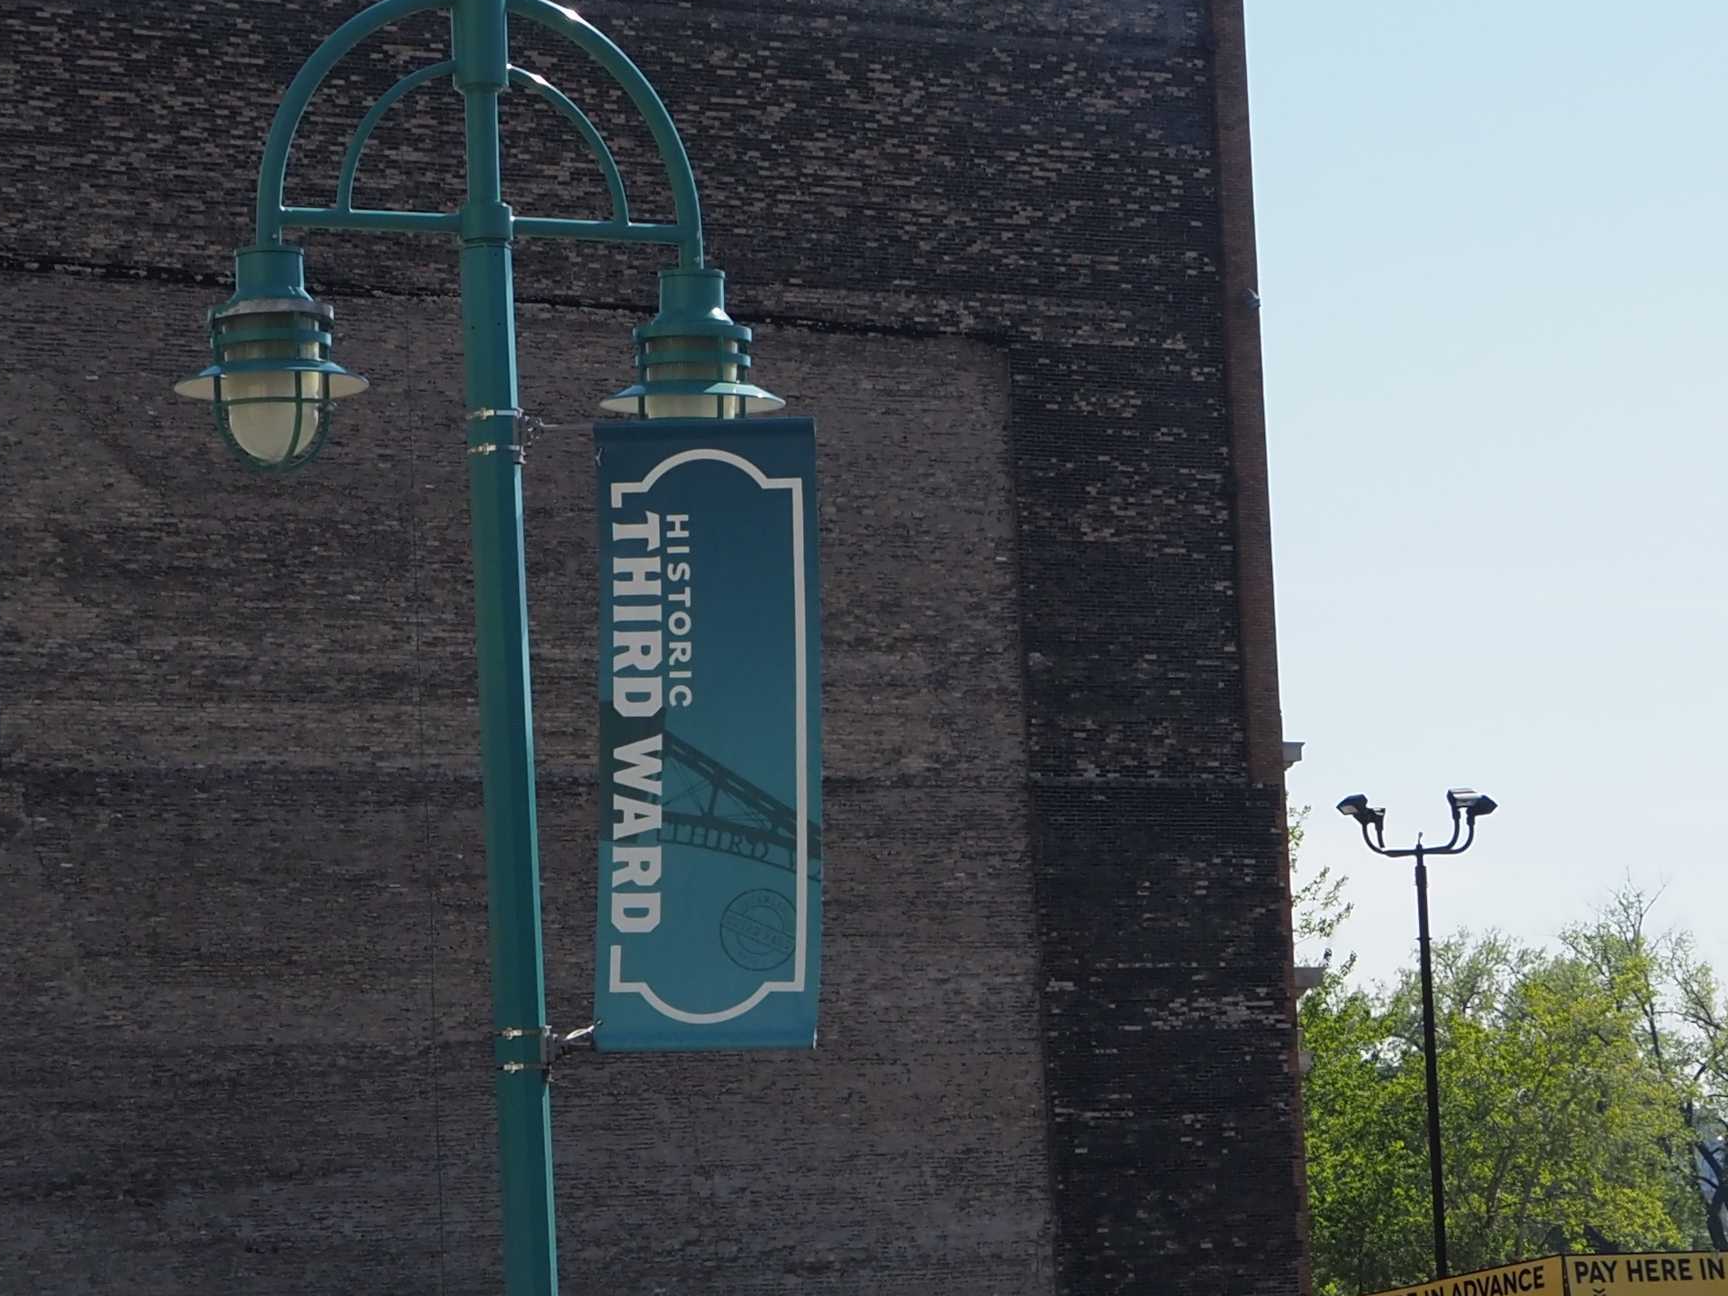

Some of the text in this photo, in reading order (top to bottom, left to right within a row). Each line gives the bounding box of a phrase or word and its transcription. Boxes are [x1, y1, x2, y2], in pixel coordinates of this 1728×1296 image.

[666, 514, 693, 709] HISTORIC
[611, 511, 663, 933] THIRD WARD
[1573, 1261, 1617, 1283] PAY
[1627, 1258, 1693, 1282] HERE
[1701, 1257, 1725, 1280] IN
